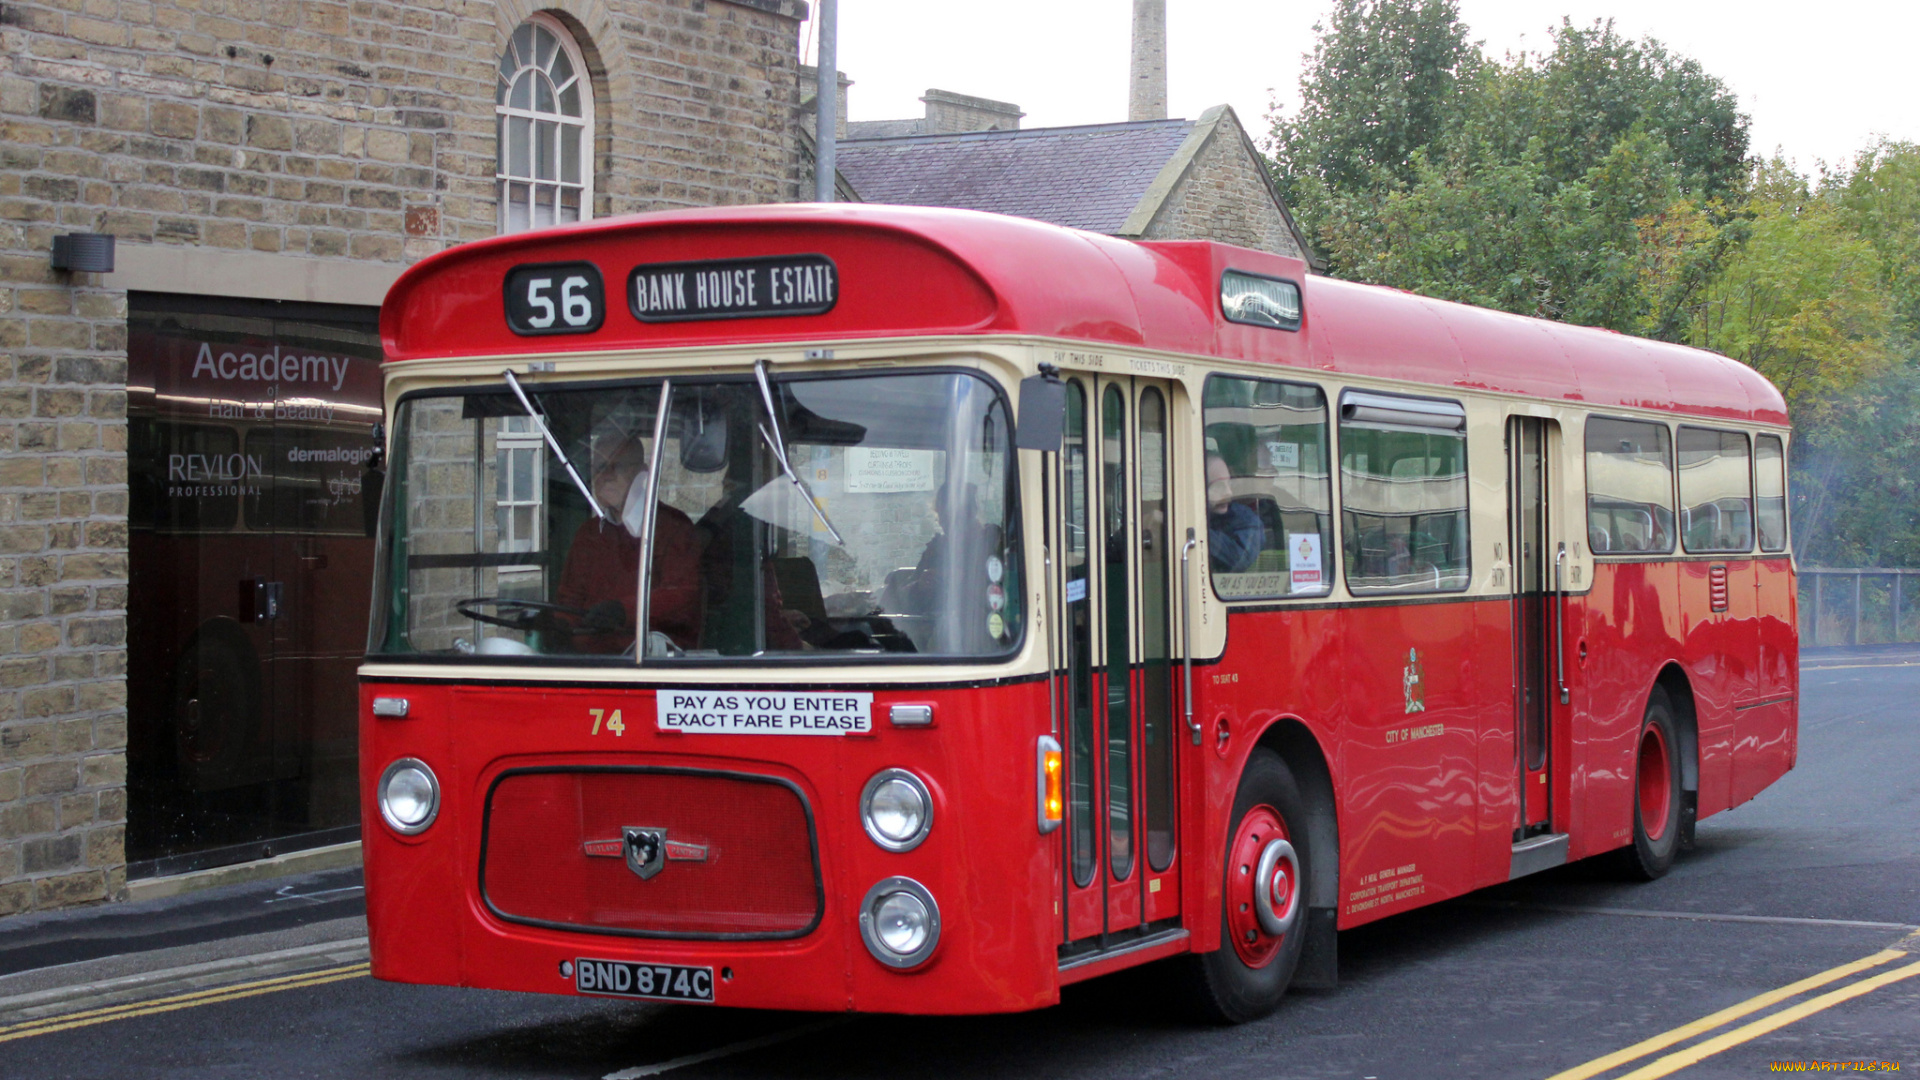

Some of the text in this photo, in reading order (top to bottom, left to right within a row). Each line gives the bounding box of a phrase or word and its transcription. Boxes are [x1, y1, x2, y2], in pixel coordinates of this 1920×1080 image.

[636, 265, 833, 312] BANK HOUSE ESTATE
[528, 276, 592, 328] 56
[192, 342, 349, 391] Academy
[1054, 351, 1103, 366] PAY THIS SIDE
[1130, 359, 1186, 376] TICKETS THIS SIDE
[267, 383, 279, 397] of
[209, 399, 334, 425] Hair & Beauty
[169, 453, 262, 481] REVLON
[288, 446, 373, 465] dermalogic
[169, 486, 262, 497] PROFESSIONAL
[329, 470, 362, 505] ghd
[673, 696, 858, 712] PAY AS YOU ENTER
[588, 708, 625, 737] 74
[666, 713, 865, 730] EXACT FARE PLEASE
[1386, 723, 1444, 743] CITY OF MANCHESTER
[579, 961, 710, 998] BND 874C
